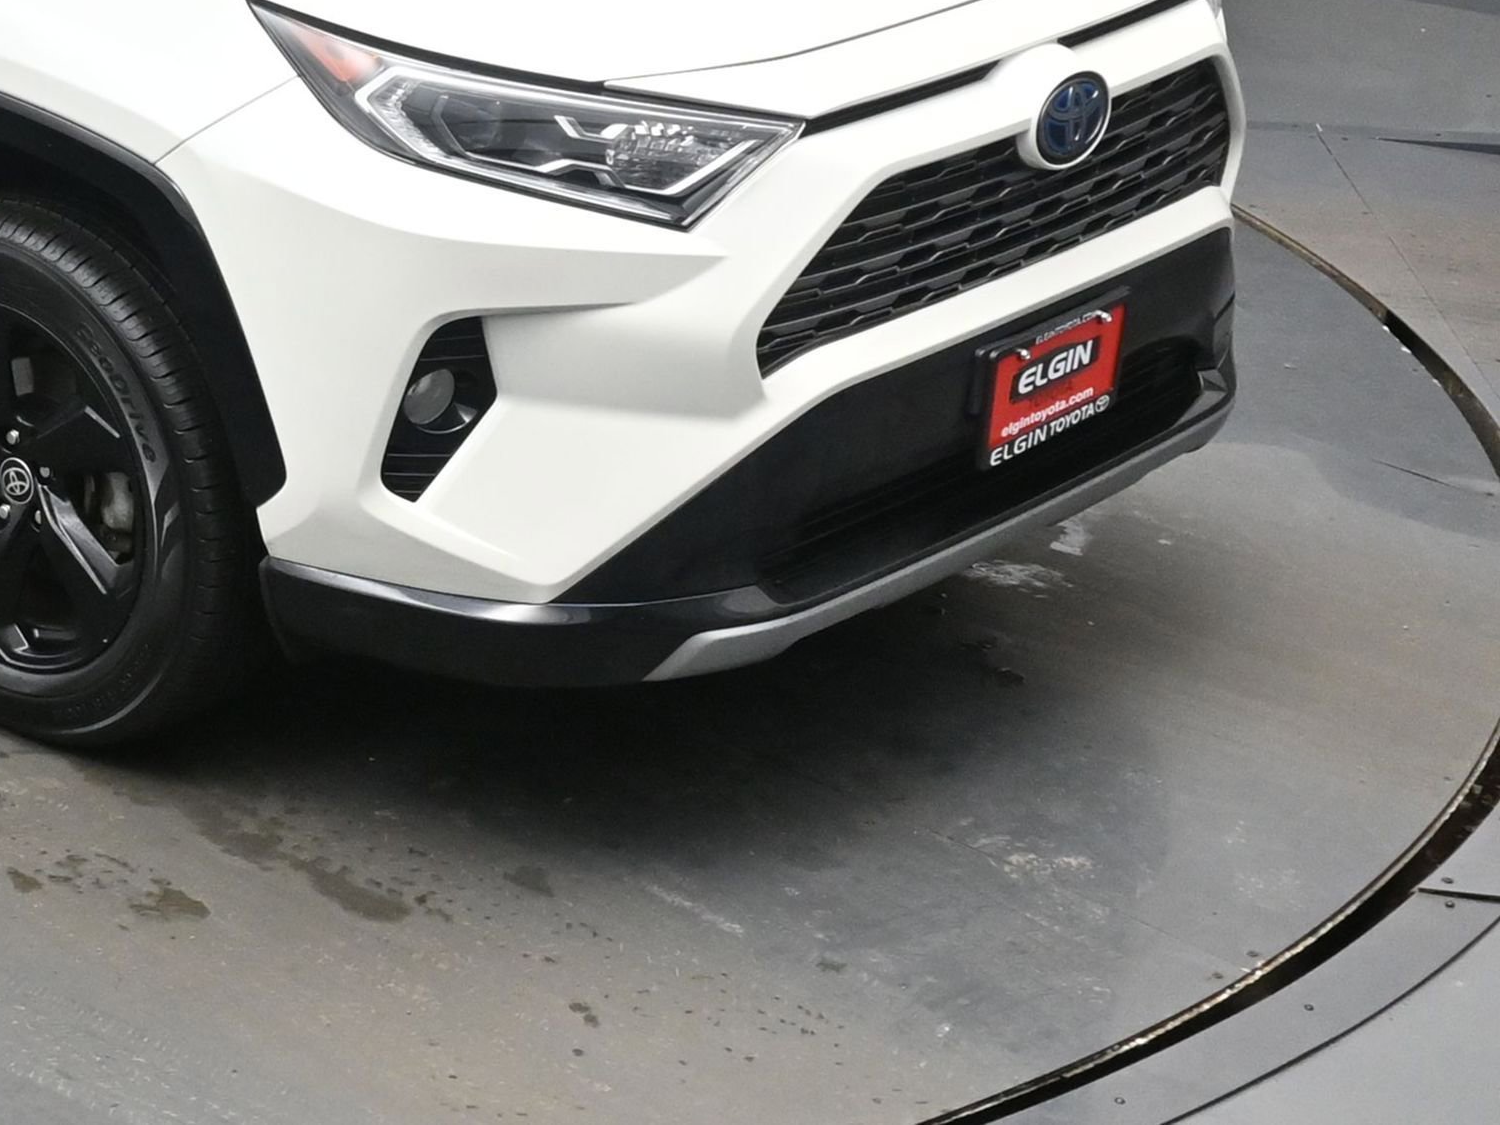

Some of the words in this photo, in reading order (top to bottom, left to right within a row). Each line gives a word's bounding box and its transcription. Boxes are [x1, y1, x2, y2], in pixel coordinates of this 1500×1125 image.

[1018, 340, 1093, 394] ELGIN
[990, 425, 1047, 466] ELGIN
[1050, 402, 1095, 436] TOYOTA
[1001, 387, 1094, 437] elgintoyota.com
